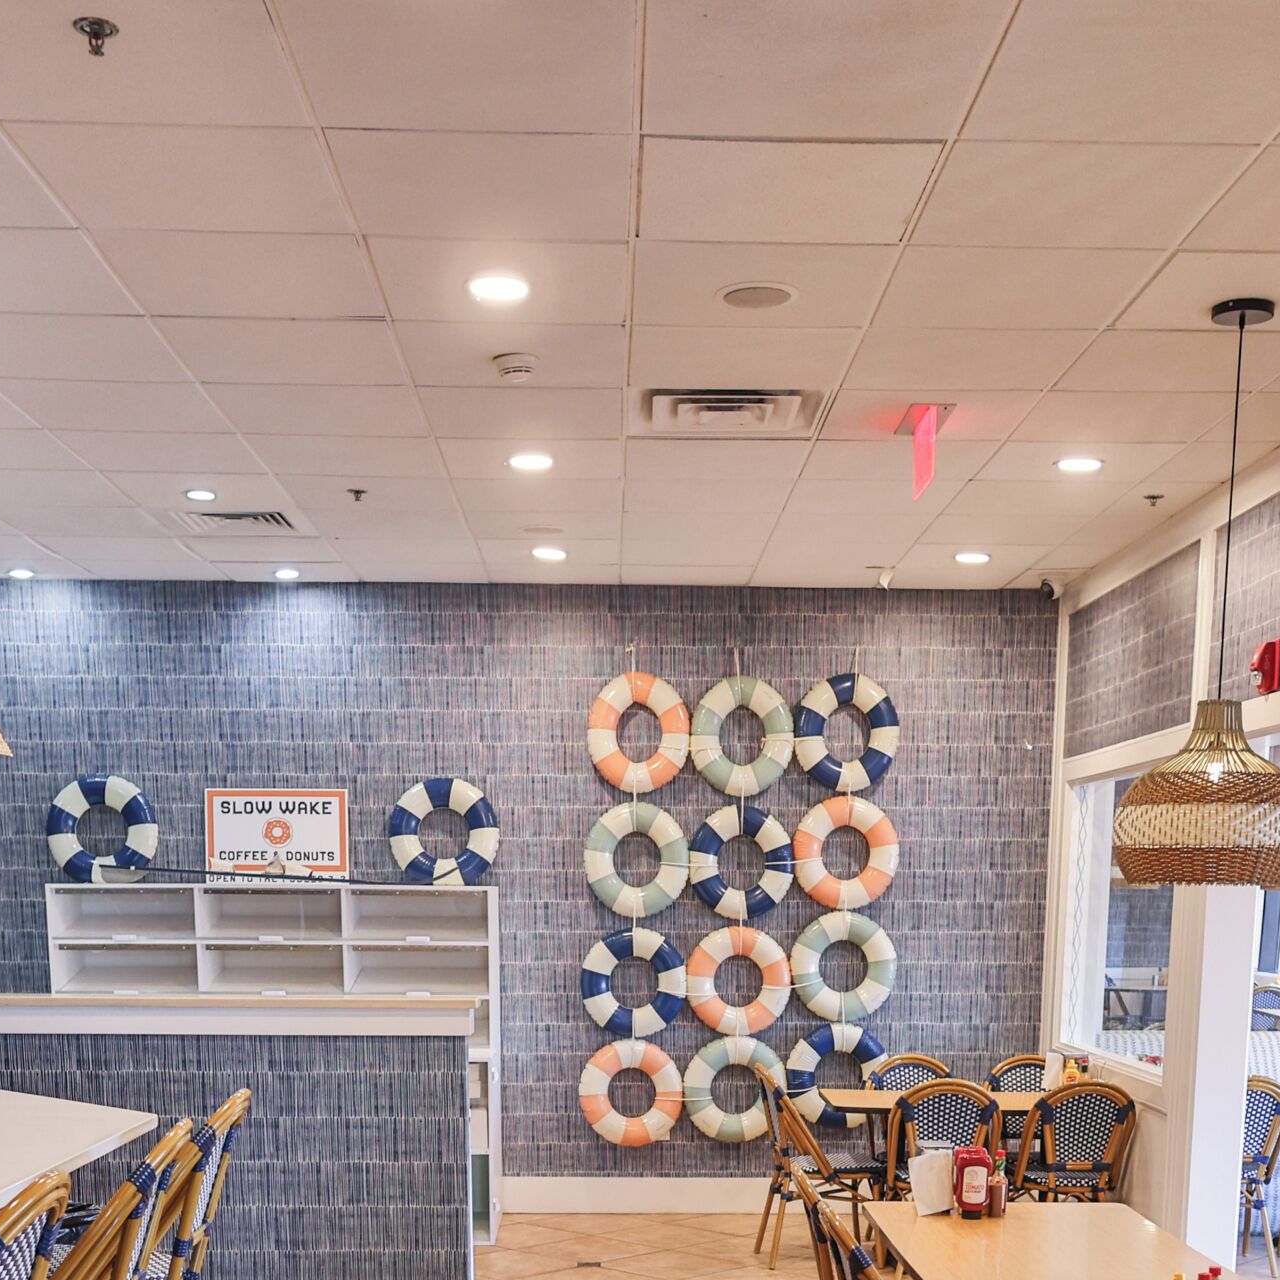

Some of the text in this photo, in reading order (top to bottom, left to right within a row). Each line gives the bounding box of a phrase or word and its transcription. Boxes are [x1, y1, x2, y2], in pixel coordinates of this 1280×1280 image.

[220, 800, 333, 815] SLOW WAKE
[219, 850, 268, 861] COFFEE
[286, 850, 335, 862] DONUTS
